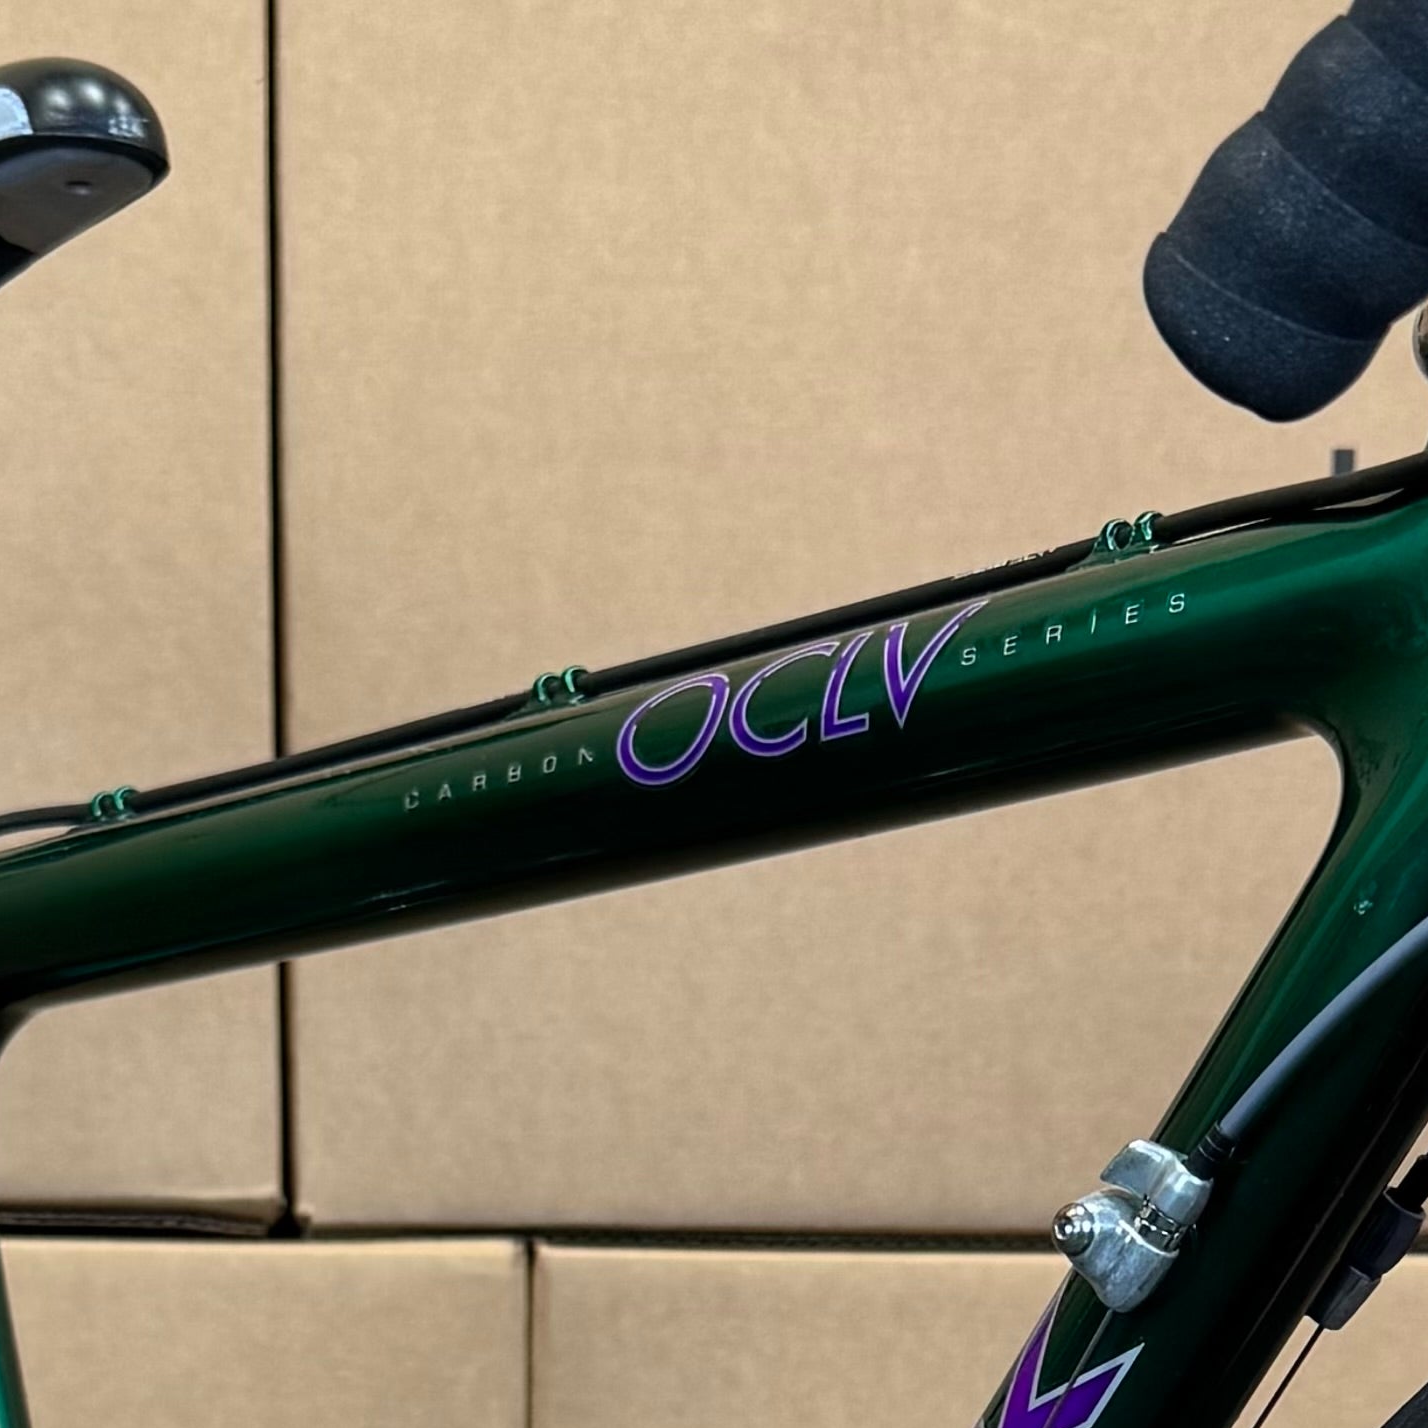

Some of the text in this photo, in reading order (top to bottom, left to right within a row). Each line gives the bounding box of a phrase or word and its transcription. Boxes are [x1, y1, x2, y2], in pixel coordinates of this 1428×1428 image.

[403, 593, 1186, 811] CARBON OCLV SERIES
